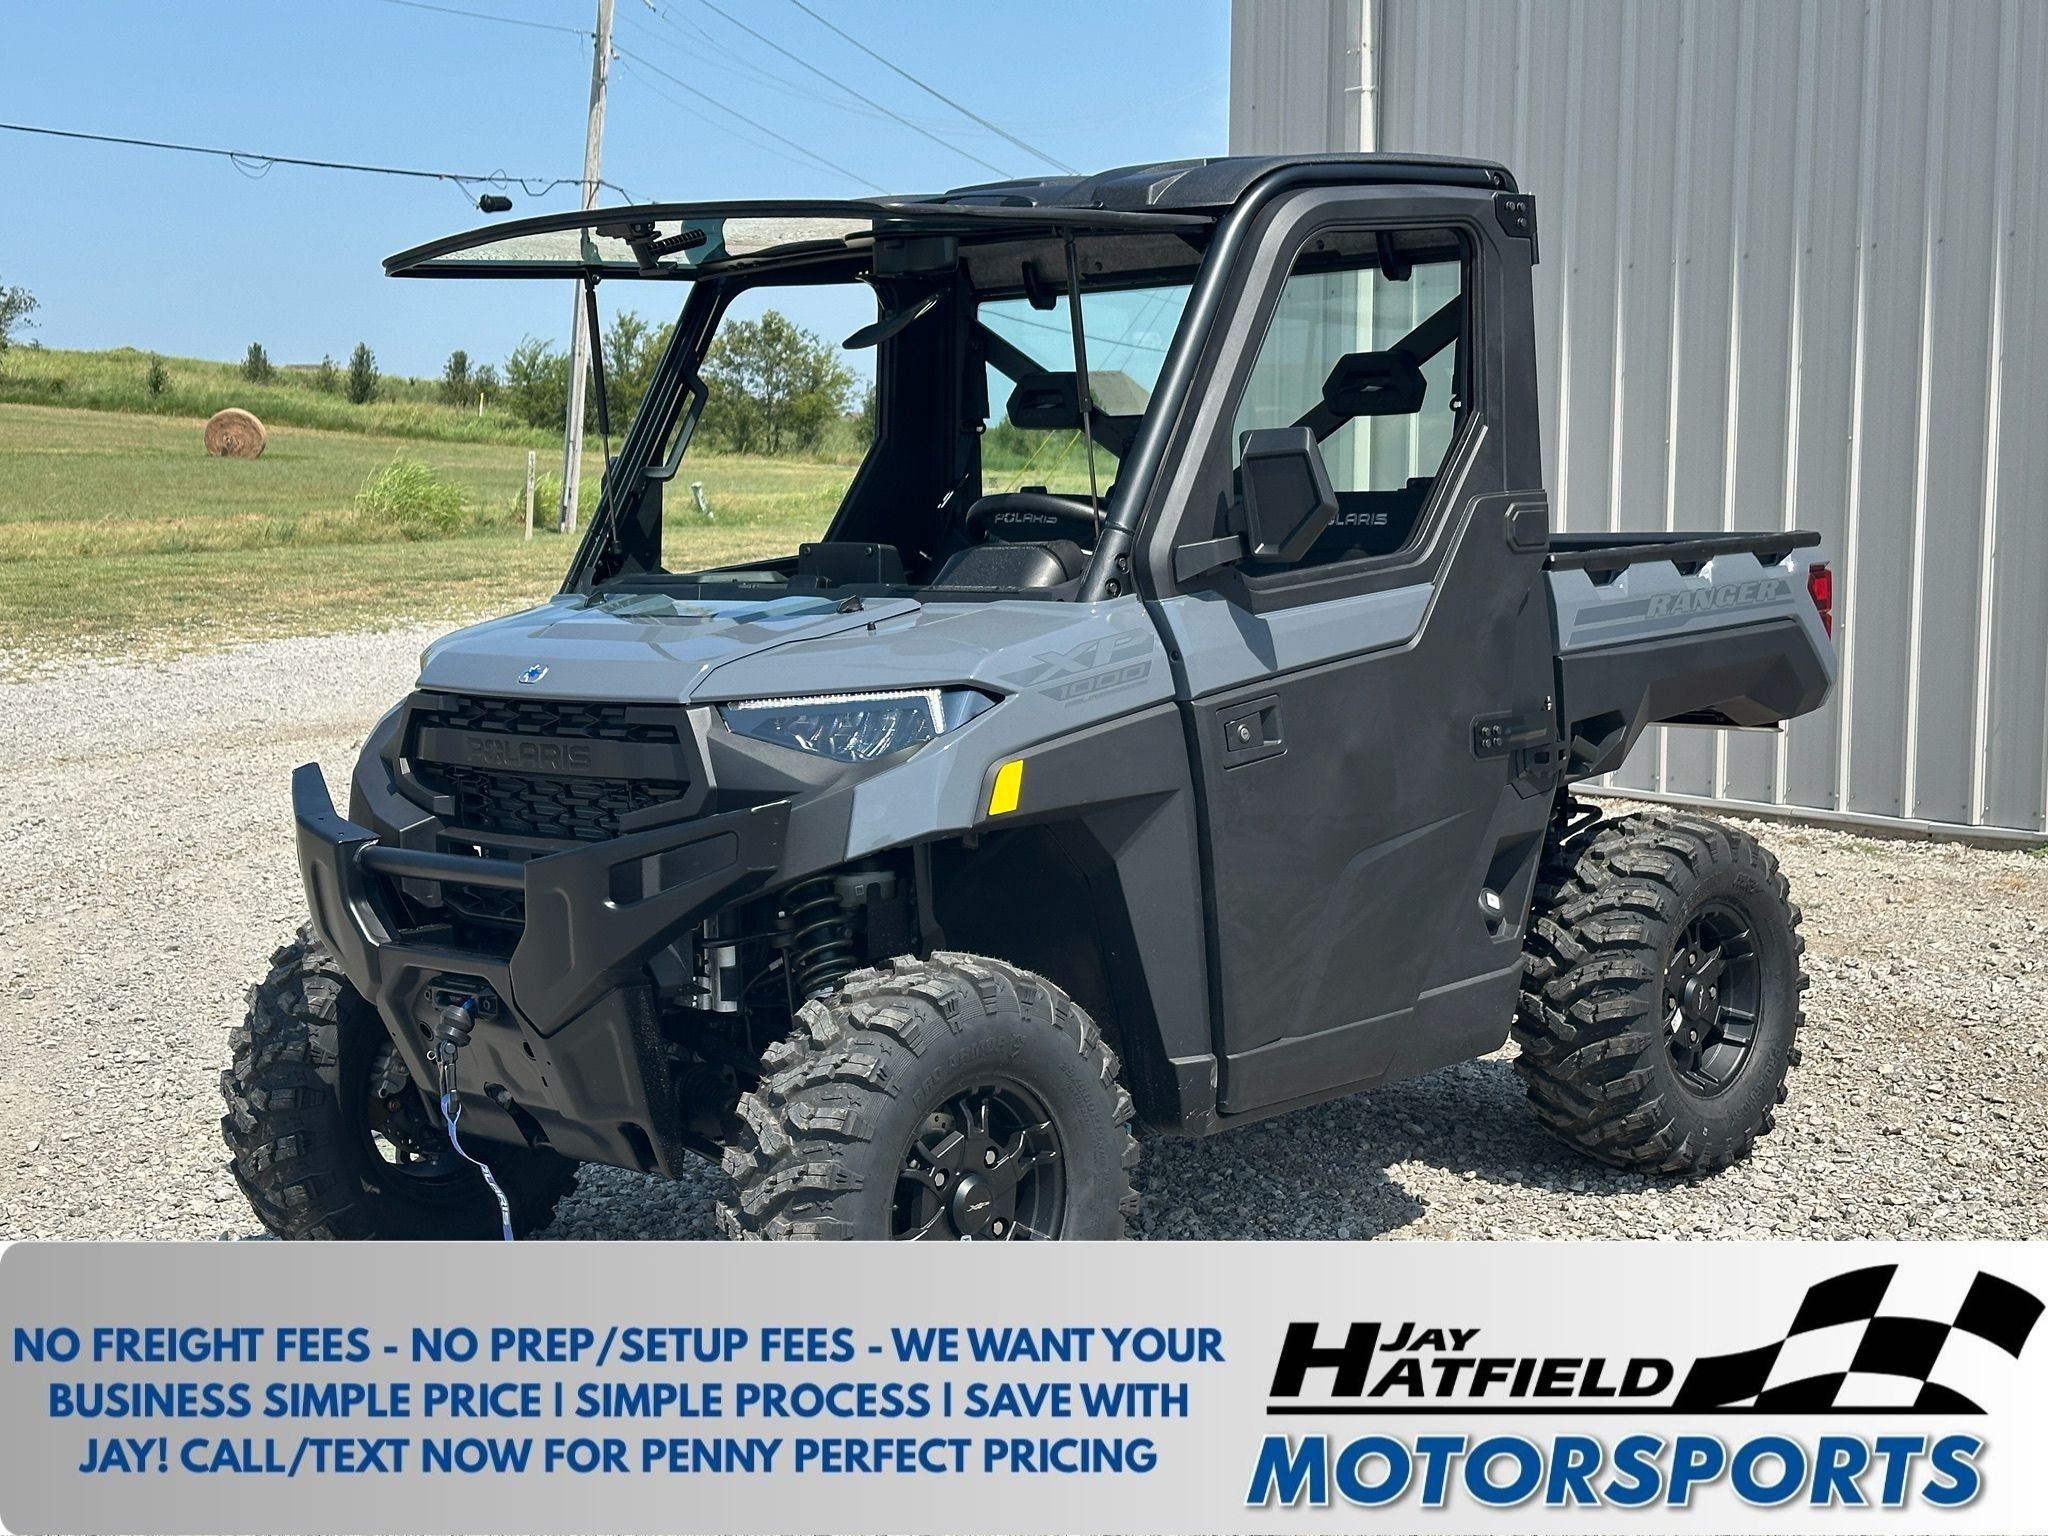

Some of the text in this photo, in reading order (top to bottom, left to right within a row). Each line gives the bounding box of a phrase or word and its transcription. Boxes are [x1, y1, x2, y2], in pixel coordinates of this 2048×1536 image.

[1328, 513, 1388, 526] LARIS
[1647, 579, 1780, 617] RANGER
[1026, 628, 1150, 687] XP
[1059, 664, 1146, 699] 1000
[466, 737, 592, 770] POLARIS
